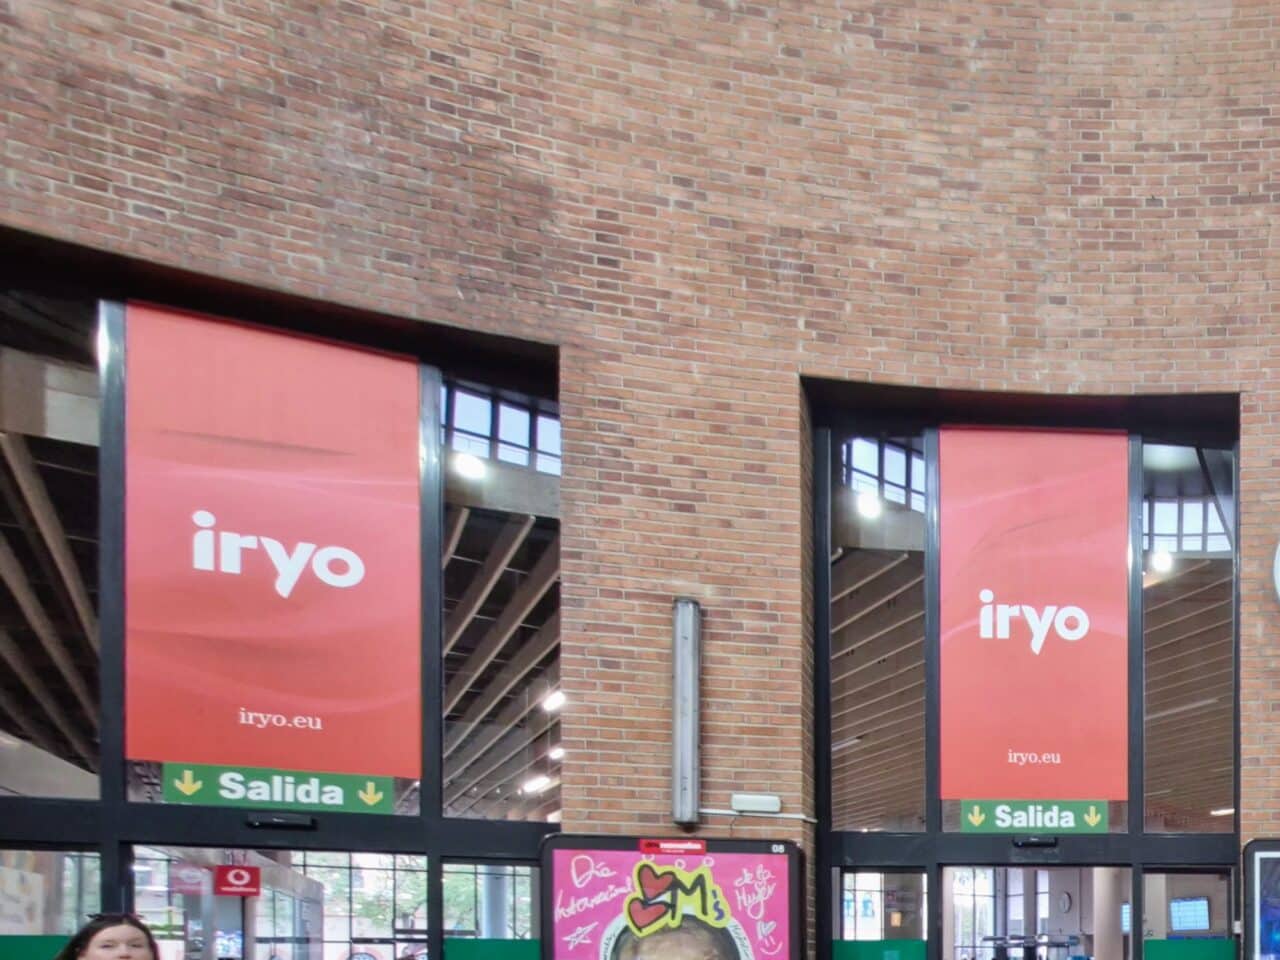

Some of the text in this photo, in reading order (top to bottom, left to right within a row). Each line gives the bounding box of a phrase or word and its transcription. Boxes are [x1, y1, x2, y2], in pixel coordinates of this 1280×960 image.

[192, 510, 365, 599] iryo
[979, 589, 1090, 655] iryo
[239, 708, 323, 729] iryo.eu
[1007, 749, 1061, 765] iryo.eu
[218, 772, 345, 806] Salida
[994, 804, 1076, 828] Salida
